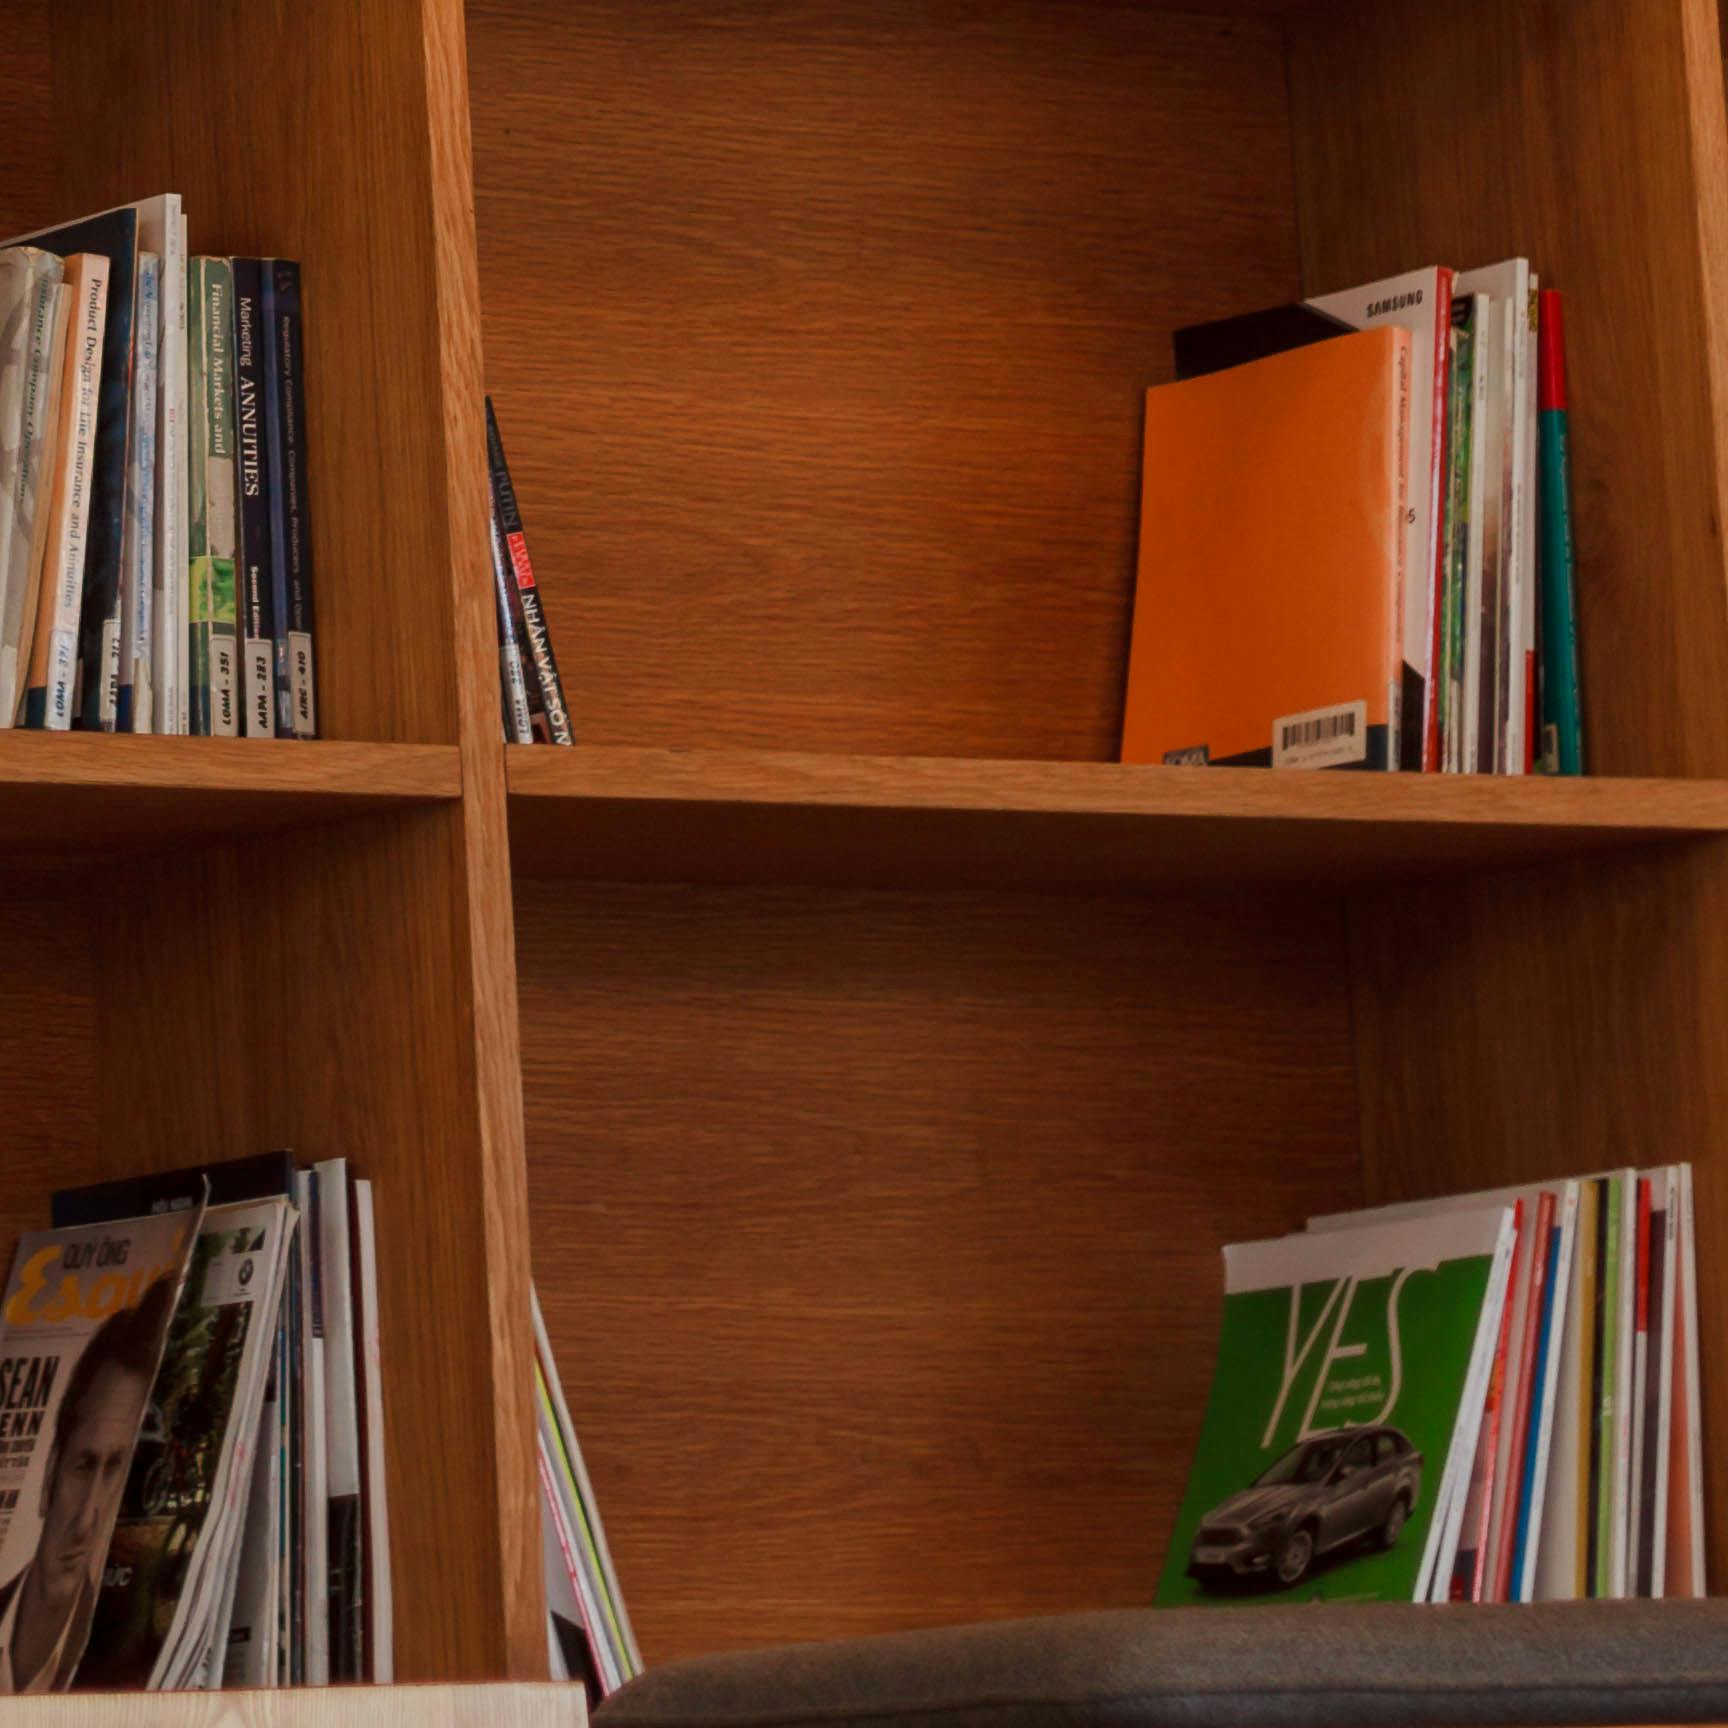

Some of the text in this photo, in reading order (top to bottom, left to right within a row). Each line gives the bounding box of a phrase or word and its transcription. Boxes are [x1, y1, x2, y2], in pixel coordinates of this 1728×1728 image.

[1365, 289, 1424, 318] SAMSUNG
[211, 281, 225, 456] Financial Markets and
[239, 296, 260, 499] Marketing ANNUITIES
[63, 277, 103, 610] Product Design for Insurance and Annuities
[495, 469, 518, 530] PUTIN
[250, 565, 260, 604] Second
[522, 593, 548, 658] NHÂN
[56, 687, 68, 718] LOMA
[220, 651, 233, 726] LOMA 351
[257, 657, 269, 730] AAPA 283
[1258, 1260, 1442, 1449] YES
